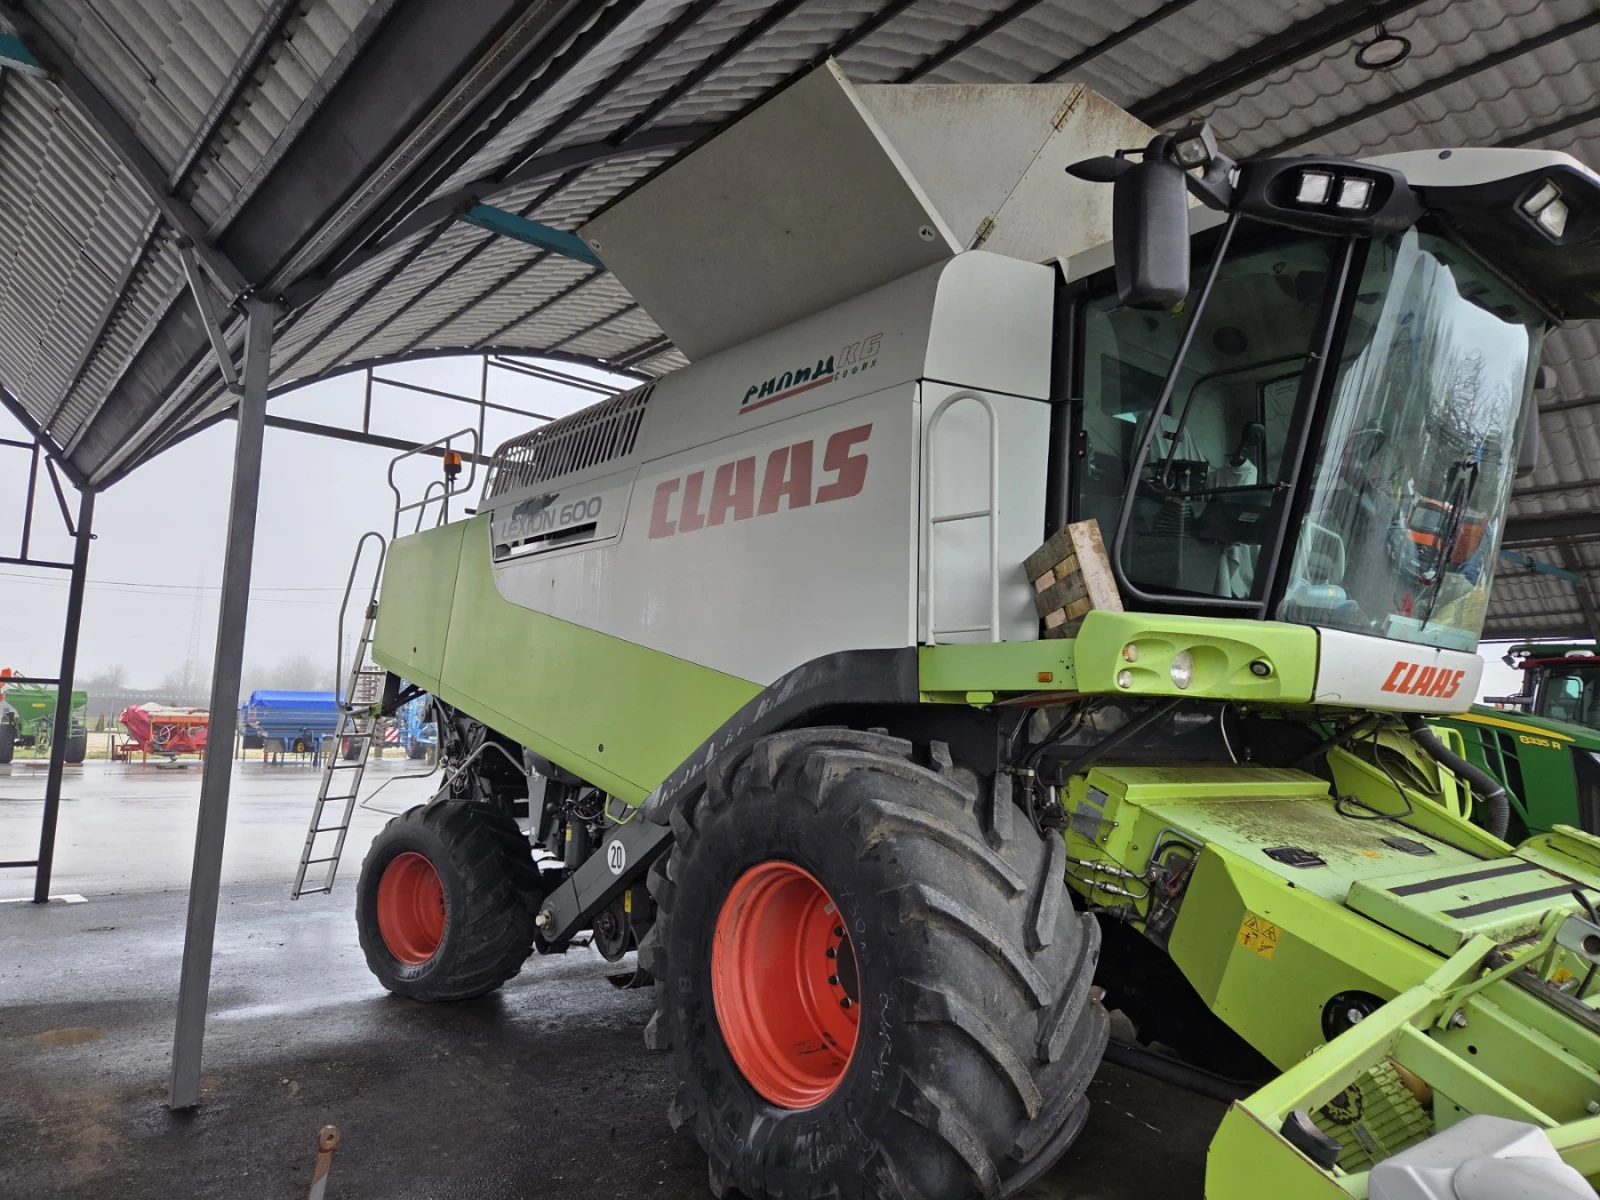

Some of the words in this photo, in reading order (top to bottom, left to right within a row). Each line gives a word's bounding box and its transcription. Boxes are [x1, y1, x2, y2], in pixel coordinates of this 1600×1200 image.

[648, 423, 873, 540] CLAAS
[501, 507, 556, 541] LEXION
[559, 496, 603, 526] 600
[1380, 660, 1466, 699] CLAAS
[1551, 741, 1562, 750] R
[610, 845, 623, 869] 20
